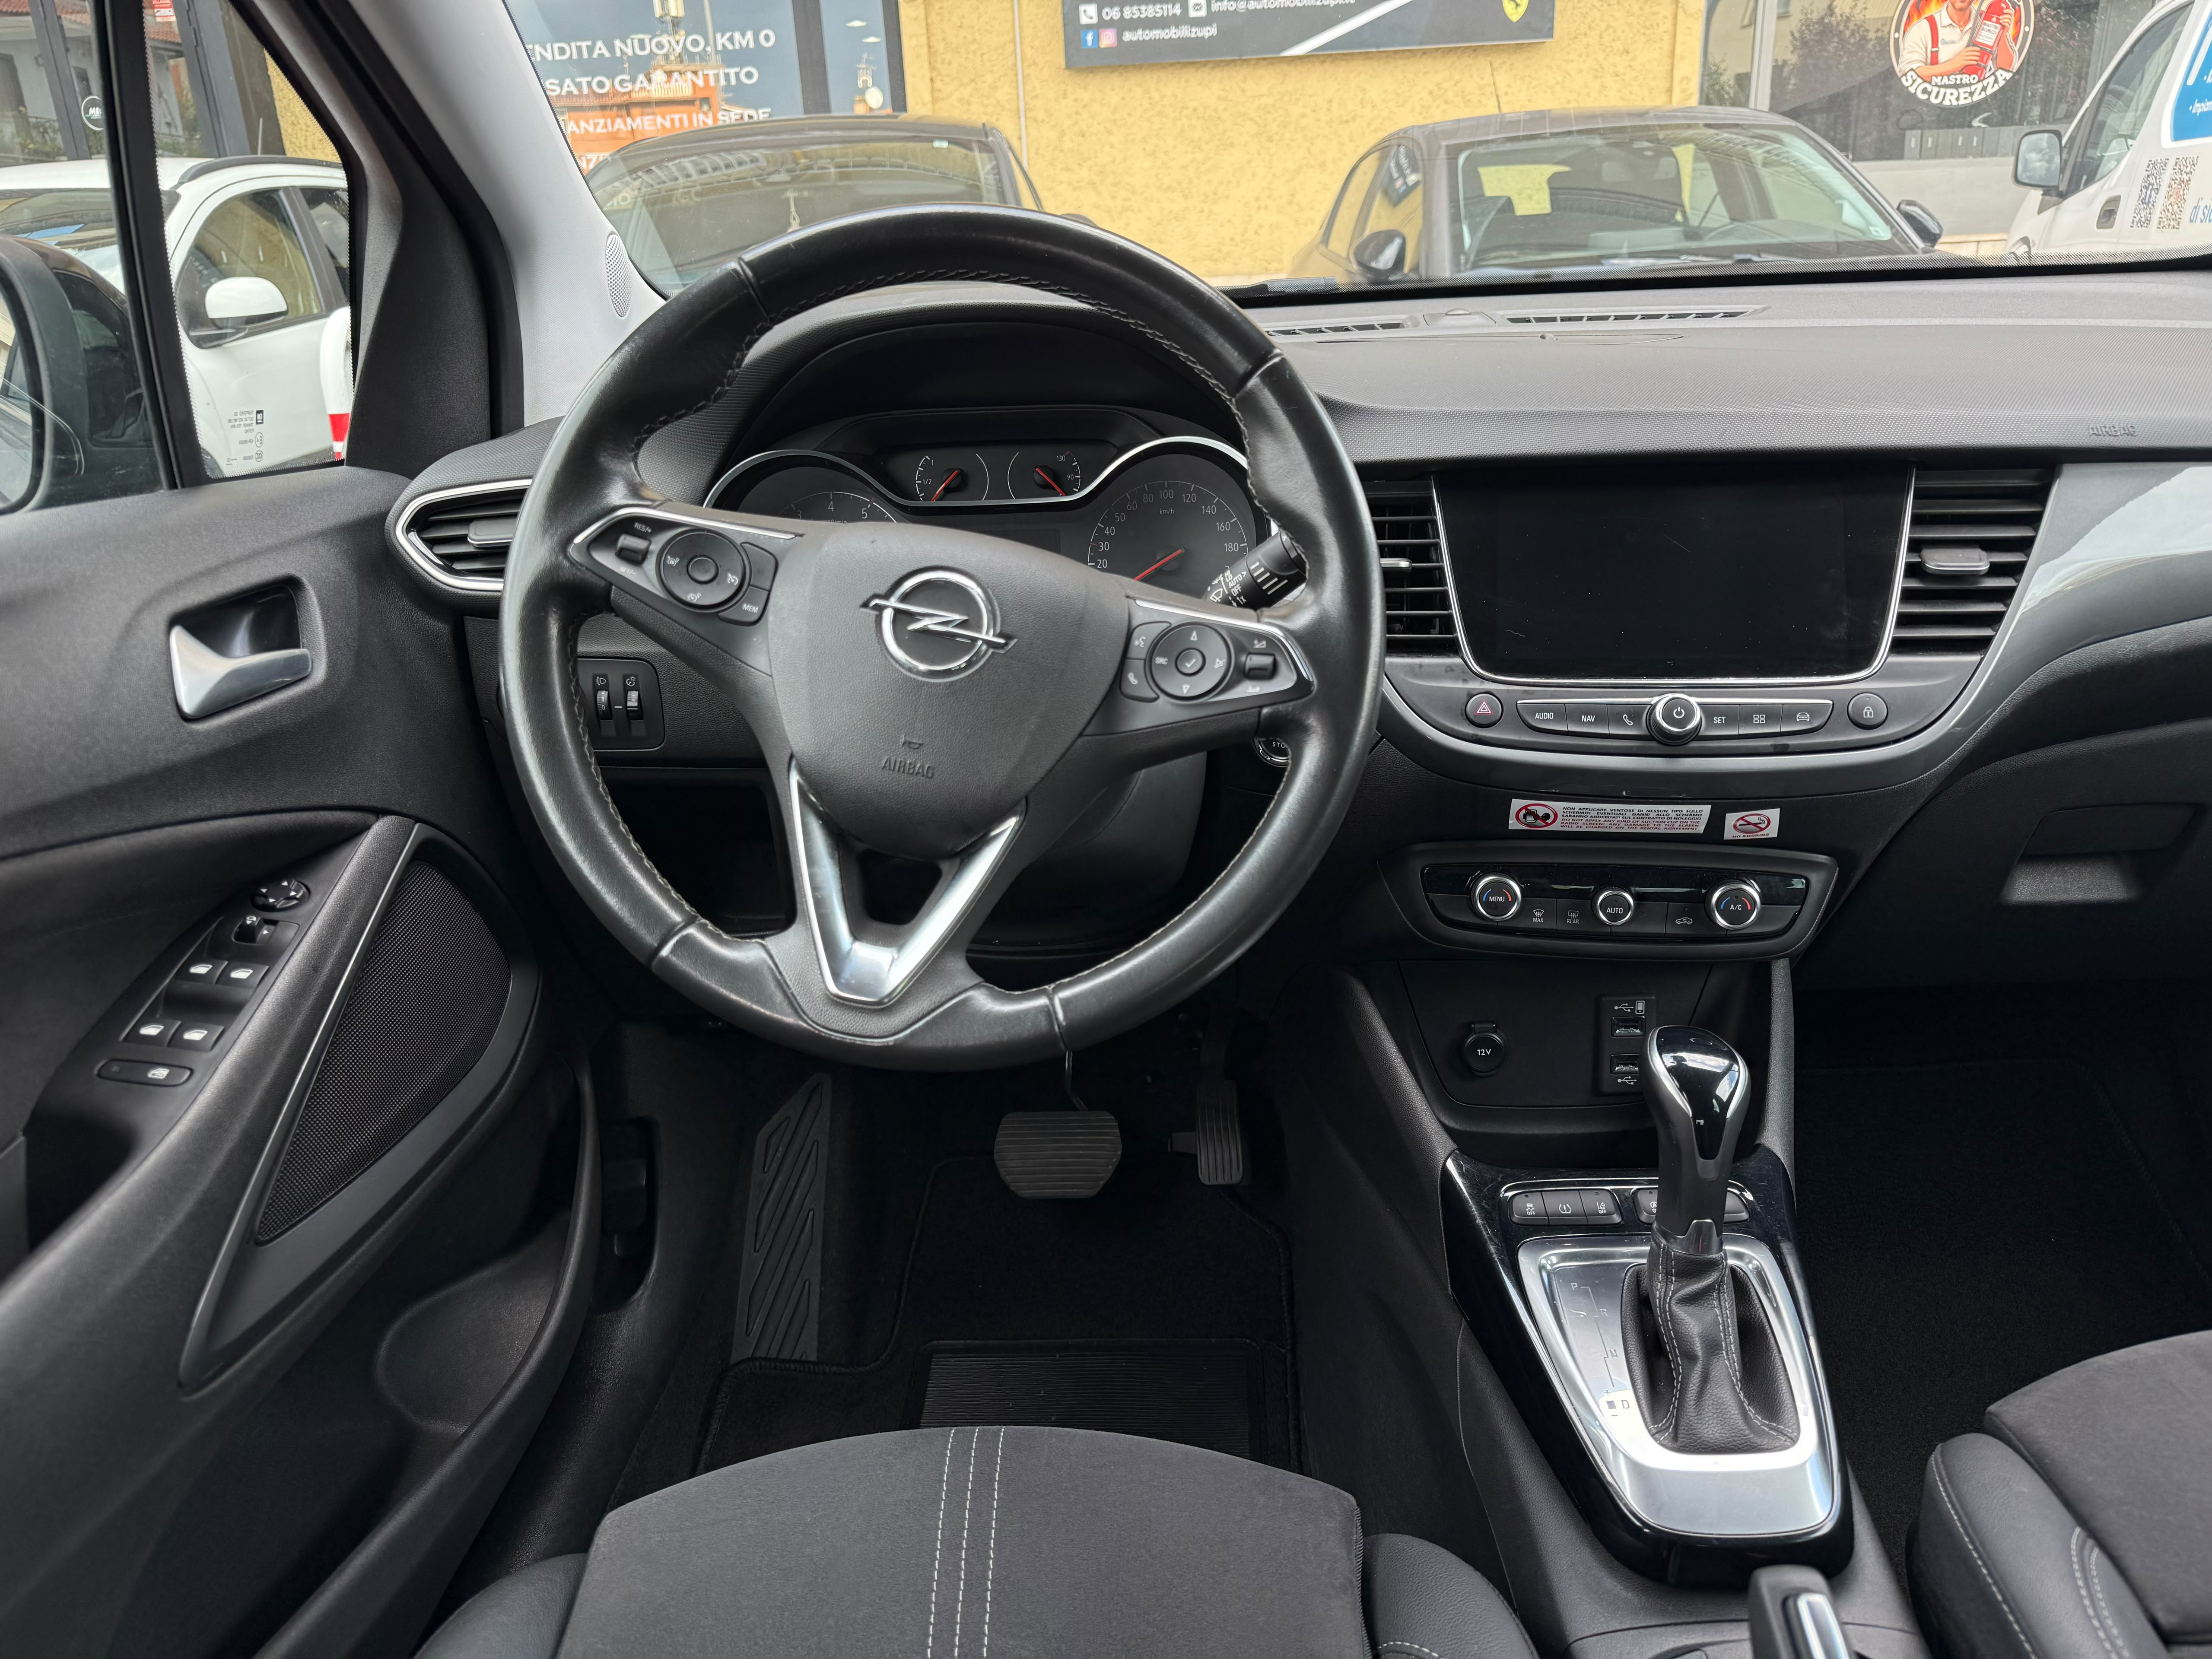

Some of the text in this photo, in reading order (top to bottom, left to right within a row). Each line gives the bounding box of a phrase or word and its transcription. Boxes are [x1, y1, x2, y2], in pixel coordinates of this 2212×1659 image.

[1102, 3, 1182, 20] 06 85385114
[1122, 22, 1217, 41] automobilizupi
[527, 29, 776, 61] NDITA NUOVO, KM 0
[613, 66, 759, 92] GARANTITO
[1932, 74, 1979, 86] MASTRO
[1901, 67, 2014, 105] SICUREZZA
[692, 112, 713, 127] IN
[717, 107, 771, 125] SEDE
[2189, 197, 2203, 223] di
[2088, 425, 2139, 437] AIRBAG
[1143, 494, 1154, 502] 80
[1159, 489, 1174, 499] 100
[1182, 493, 1196, 502] 120
[828, 501, 834, 512] 4
[1127, 501, 1137, 510] 60
[1201, 505, 1216, 514] 140
[796, 510, 802, 519] 3
[861, 508, 868, 519] 5
[1115, 513, 1125, 522] 50
[1104, 526, 1115, 535] 40
[1216, 521, 1230, 531] 160
[1099, 542, 1109, 551] 30
[1224, 543, 1239, 552] 180
[1097, 559, 1107, 568] 20
[1228, 573, 1243, 589] AUTO
[1231, 584, 1241, 597] OFF
[742, 604, 759, 613] MEM
[881, 757, 934, 779] AIRBAG
[1570, 1282, 1578, 1290] P
[1599, 1308, 1609, 1318] R
[1609, 1348, 1618, 1358] N
[1621, 1399, 1630, 1409] D
